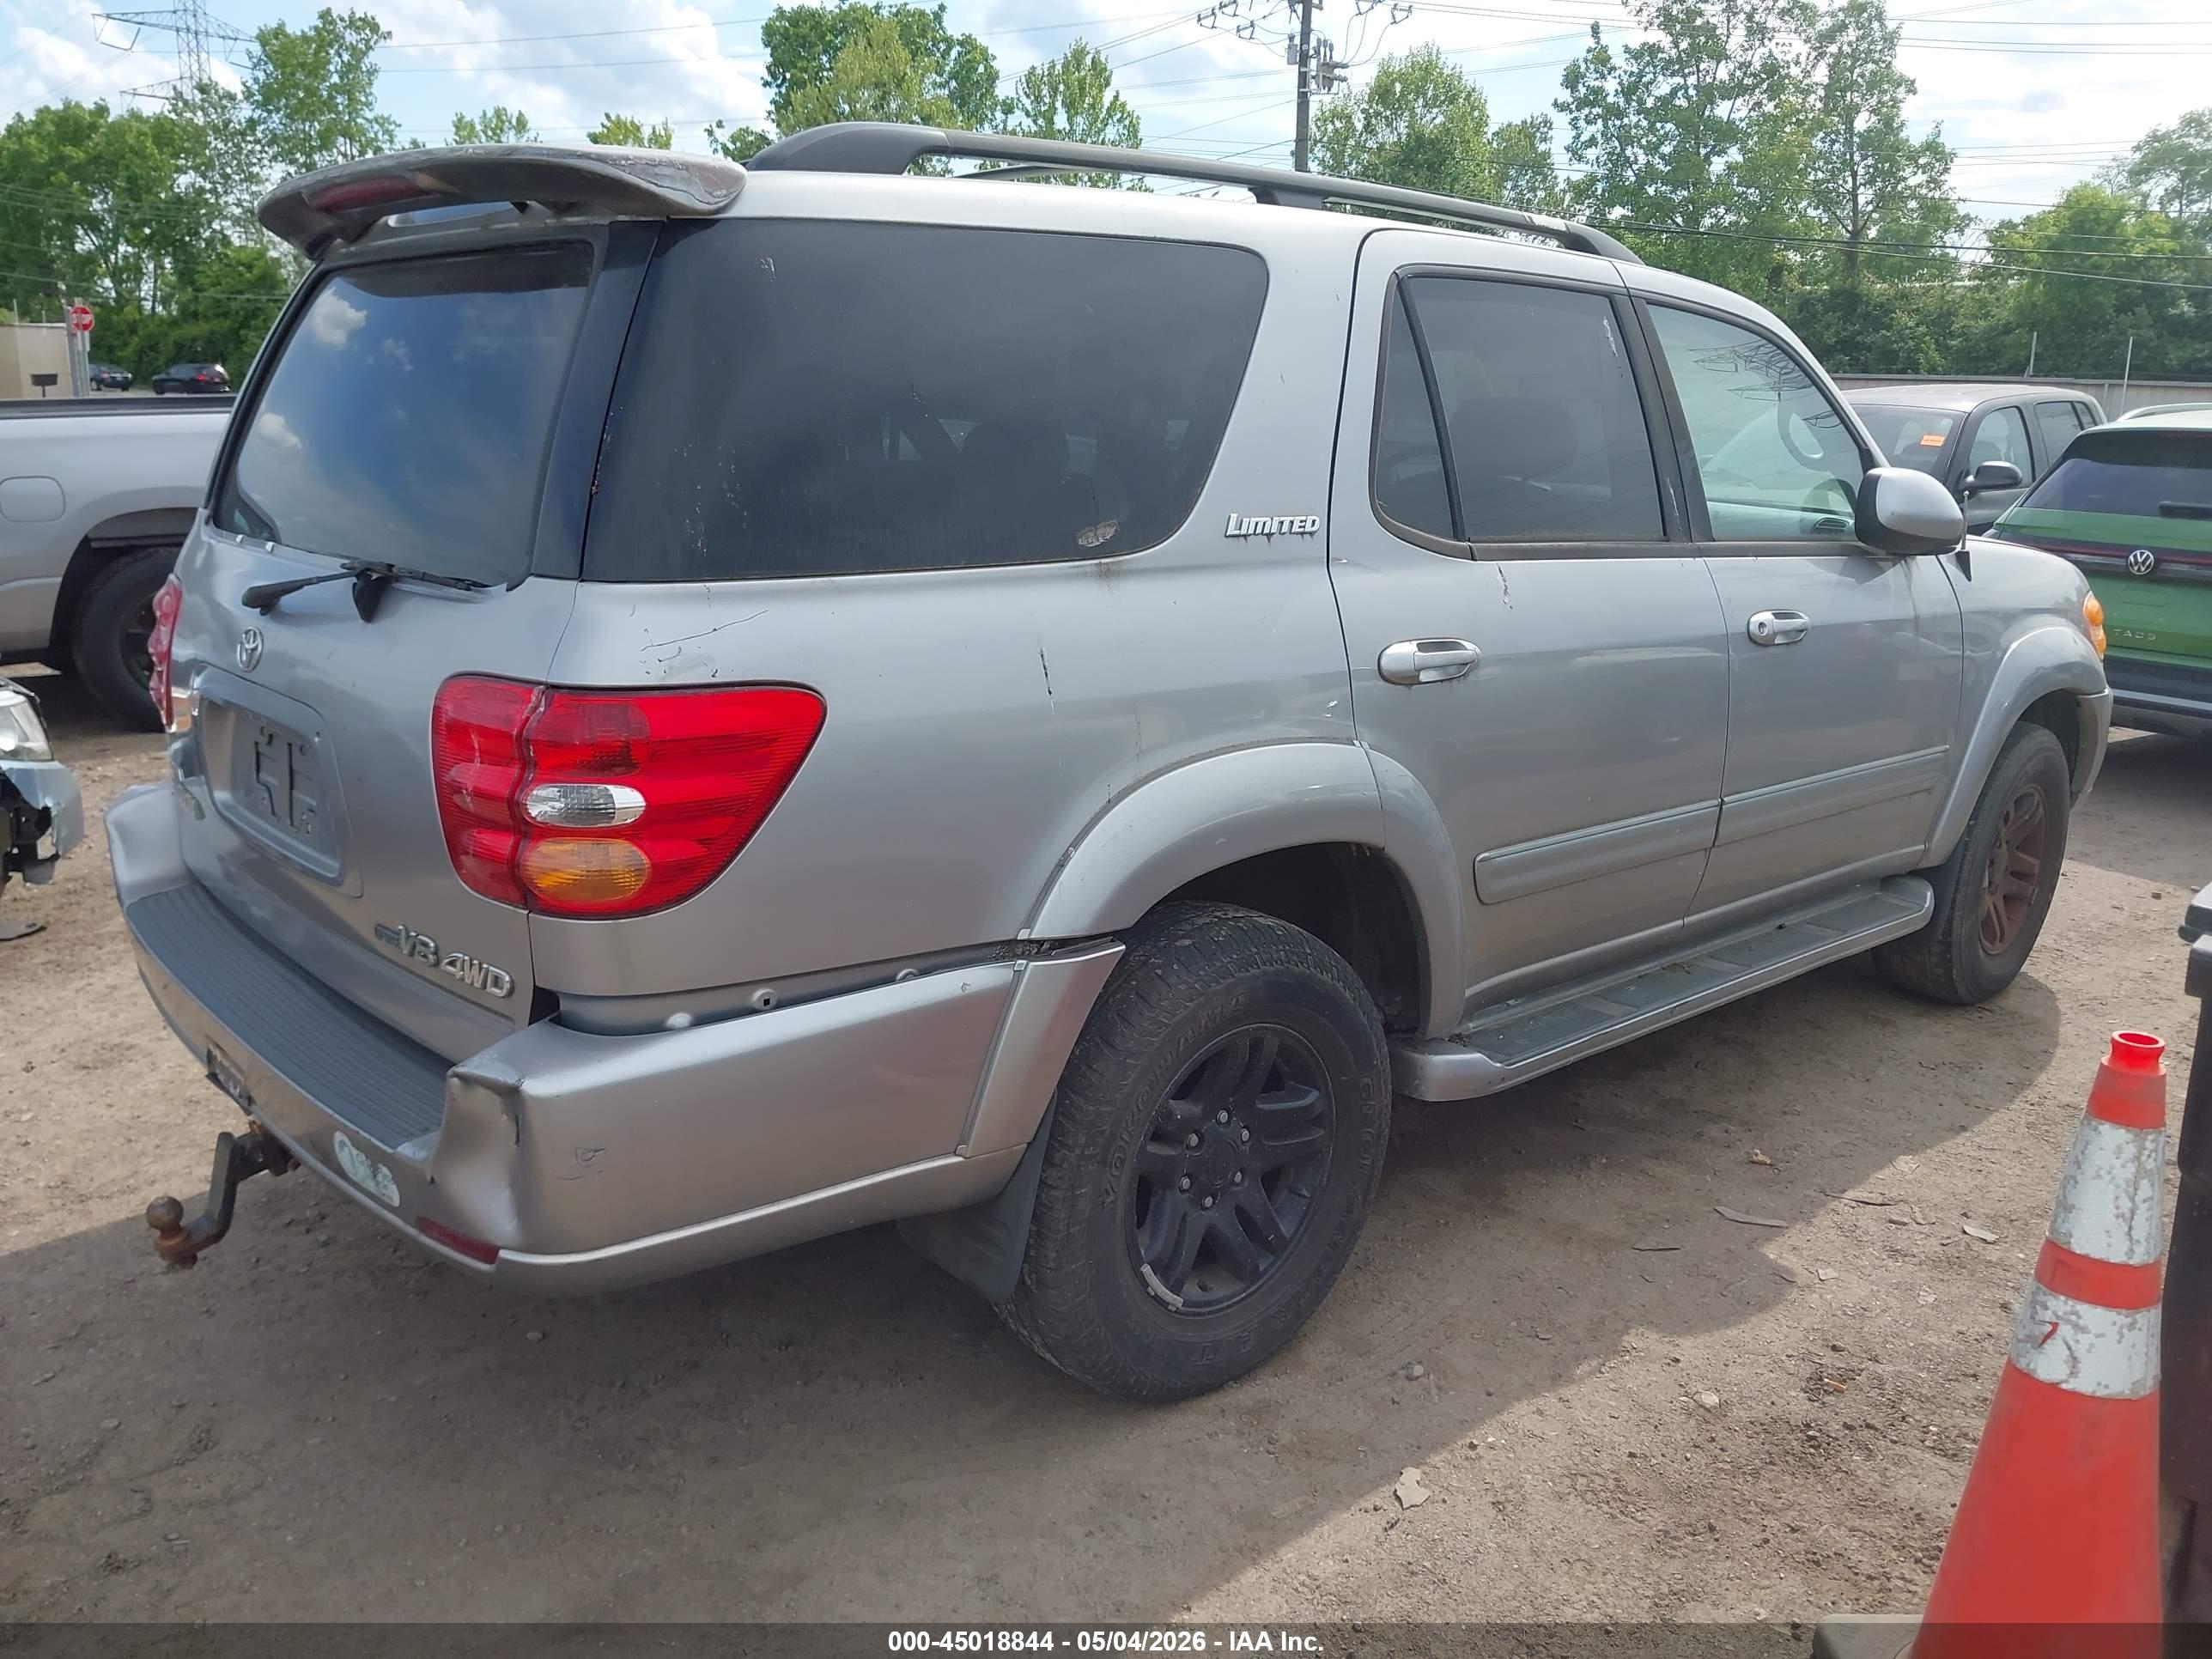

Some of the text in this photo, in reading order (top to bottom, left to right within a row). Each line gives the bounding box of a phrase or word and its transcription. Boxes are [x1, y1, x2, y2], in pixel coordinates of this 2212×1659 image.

[71, 313, 91, 325] SOP
[1224, 513, 1321, 538] LIMITED
[2113, 628, 2156, 641] TAOS
[398, 924, 439, 967] V8
[441, 952, 515, 999] 4WD
[1103, 993, 1246, 1206] YOKOHAMA
